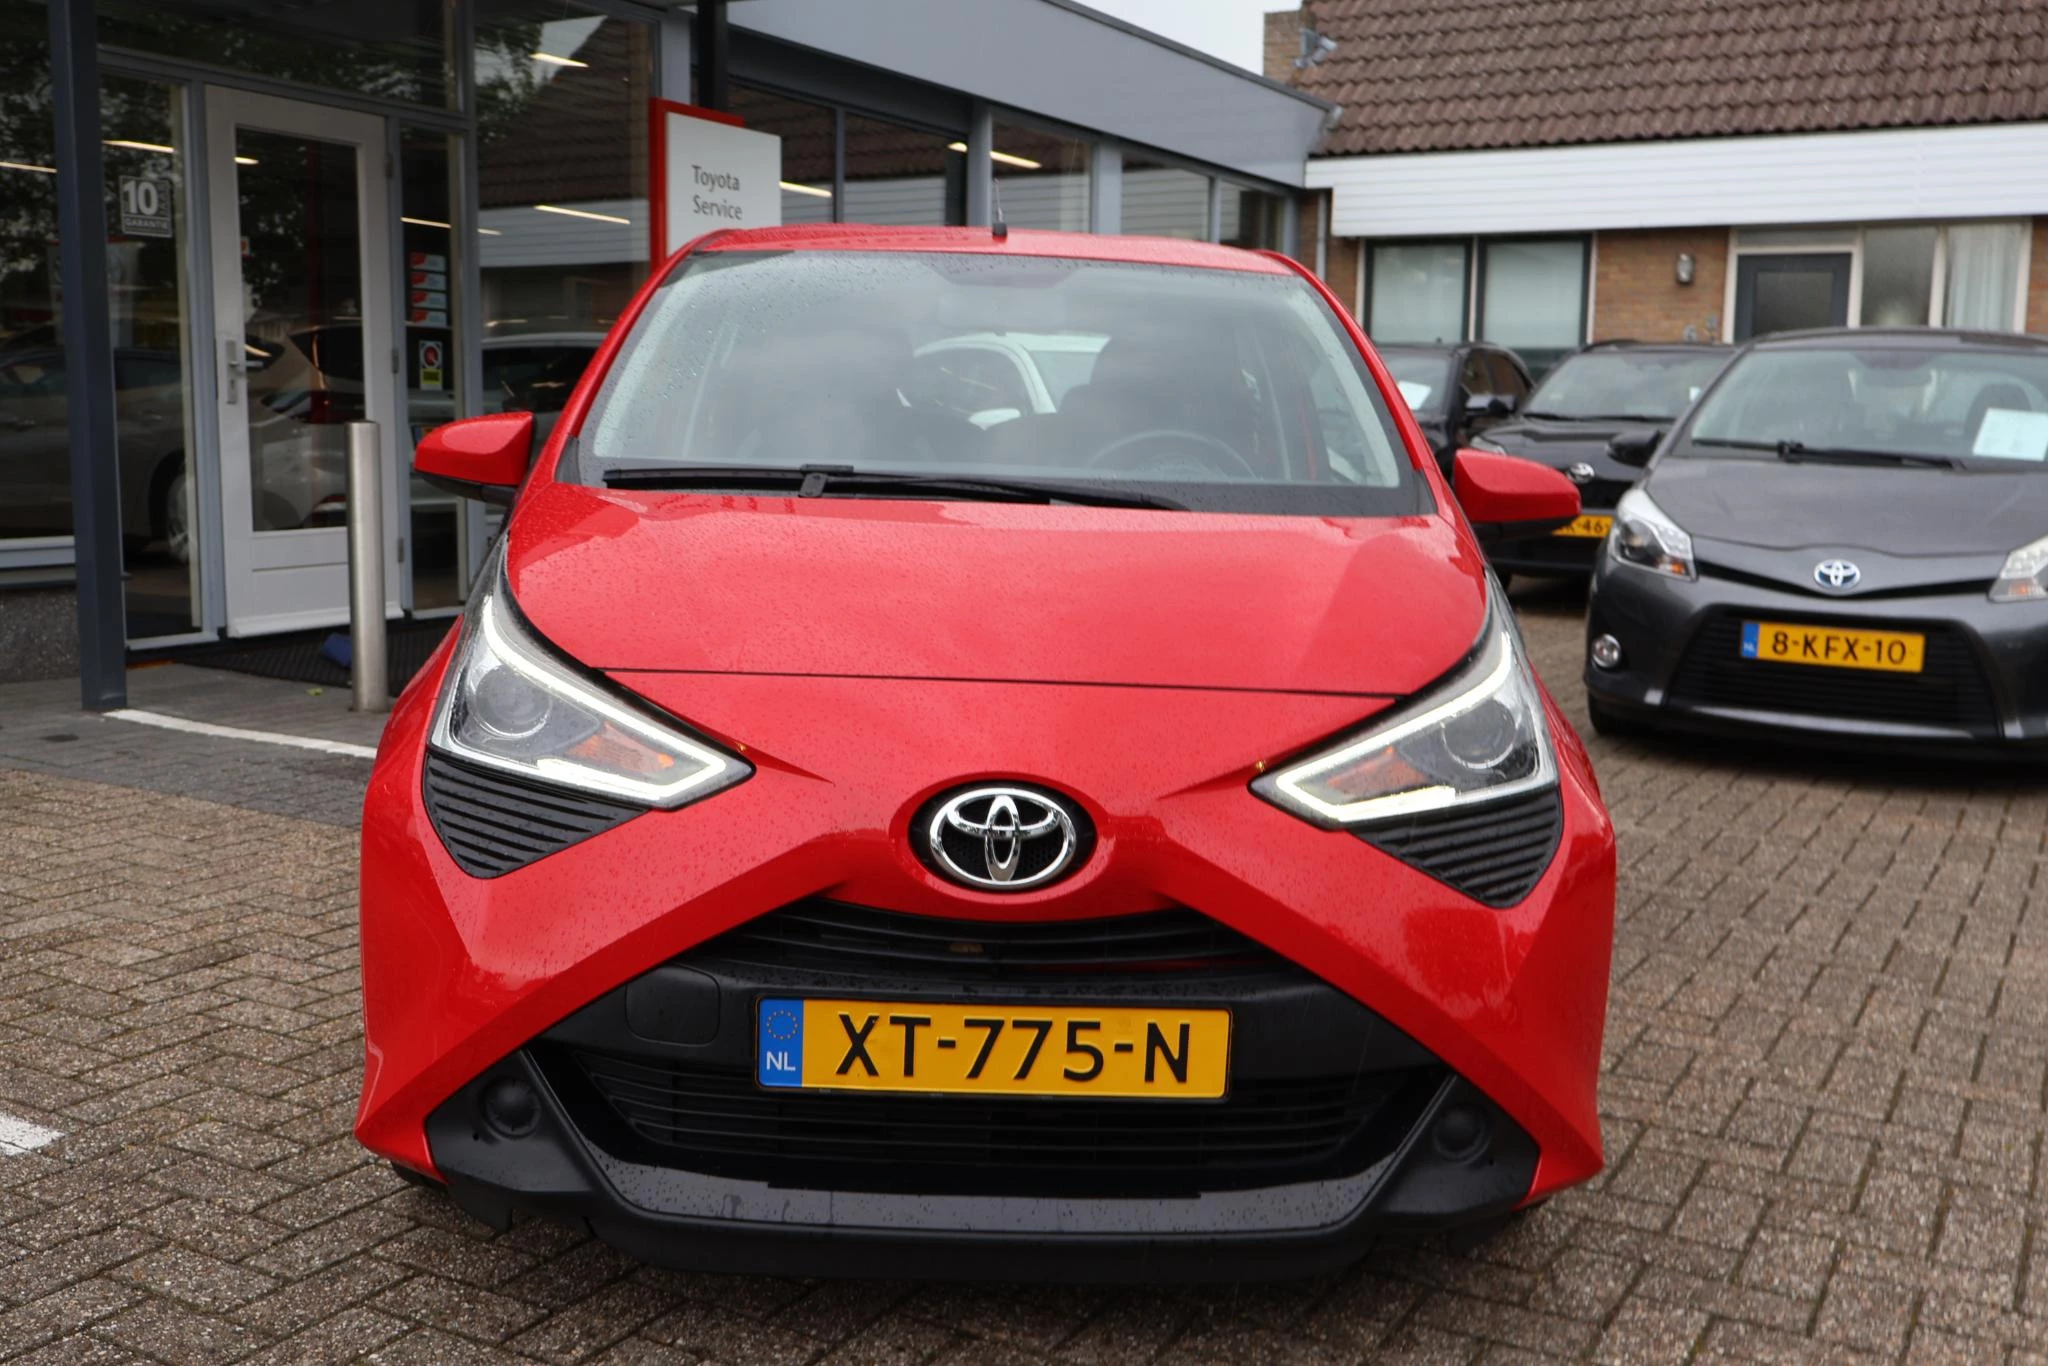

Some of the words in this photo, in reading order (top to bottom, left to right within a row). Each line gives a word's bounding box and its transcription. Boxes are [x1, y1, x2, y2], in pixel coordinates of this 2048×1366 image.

[691, 164, 740, 192] Toyota
[123, 180, 158, 215] 10
[692, 194, 743, 220] Service
[1771, 630, 1907, 665] 8-KFX-10
[766, 1051, 796, 1071] NL
[835, 1013, 1191, 1084] XT-775-N
